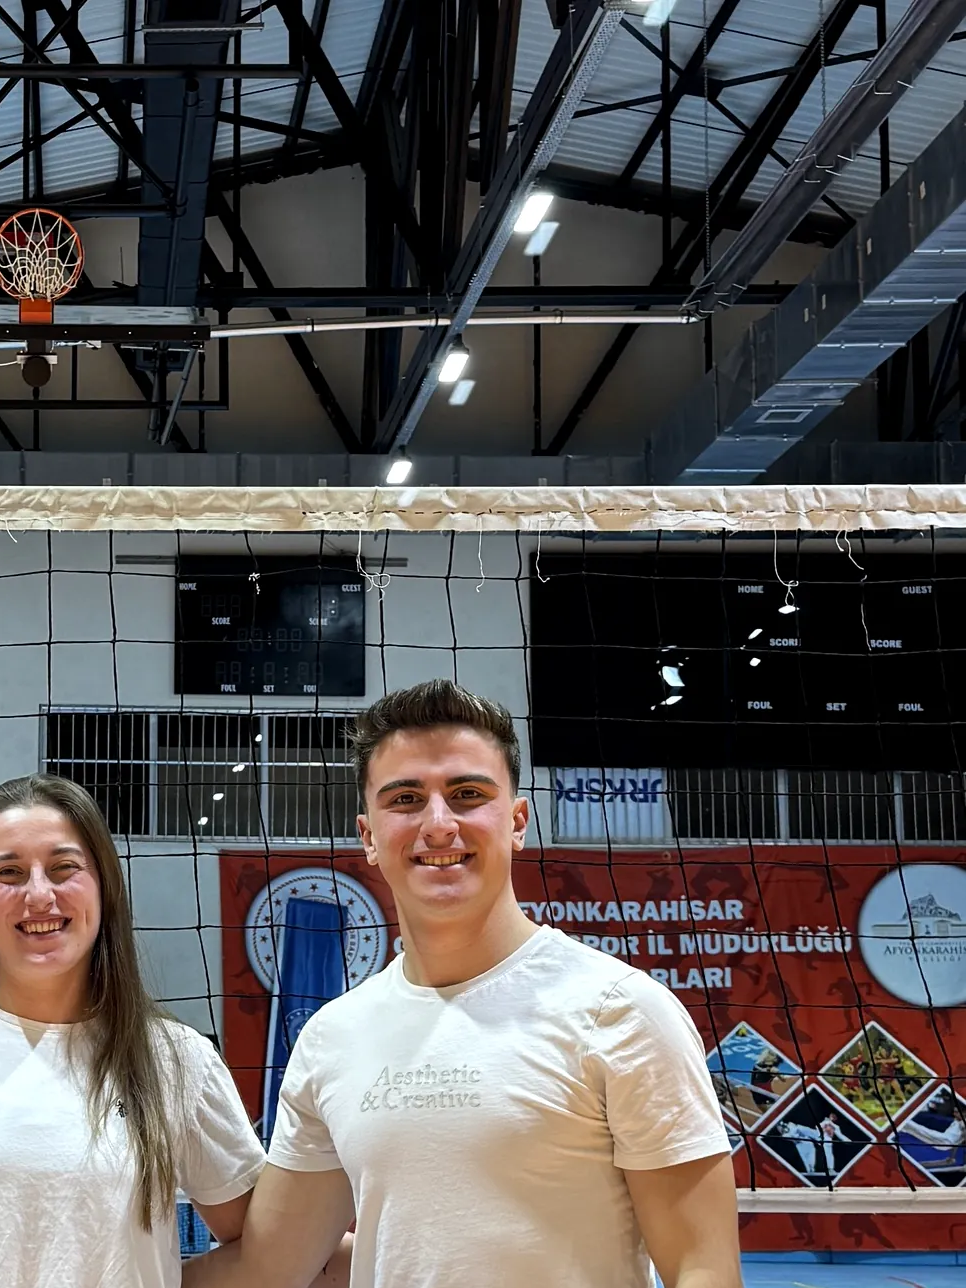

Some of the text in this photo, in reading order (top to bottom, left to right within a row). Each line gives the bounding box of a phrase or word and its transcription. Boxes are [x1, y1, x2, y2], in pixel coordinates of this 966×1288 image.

[738, 585, 764, 594] HOME
[902, 586, 932, 595] GUEST
[211, 617, 230, 625] SCORE
[870, 639, 902, 648] SCORE
[263, 685, 275, 693] SET
[748, 701, 924, 712] FOUL SET FOUL
[648, 929, 673, 956] İL
[372, 1063, 482, 1088] Aesthetic
